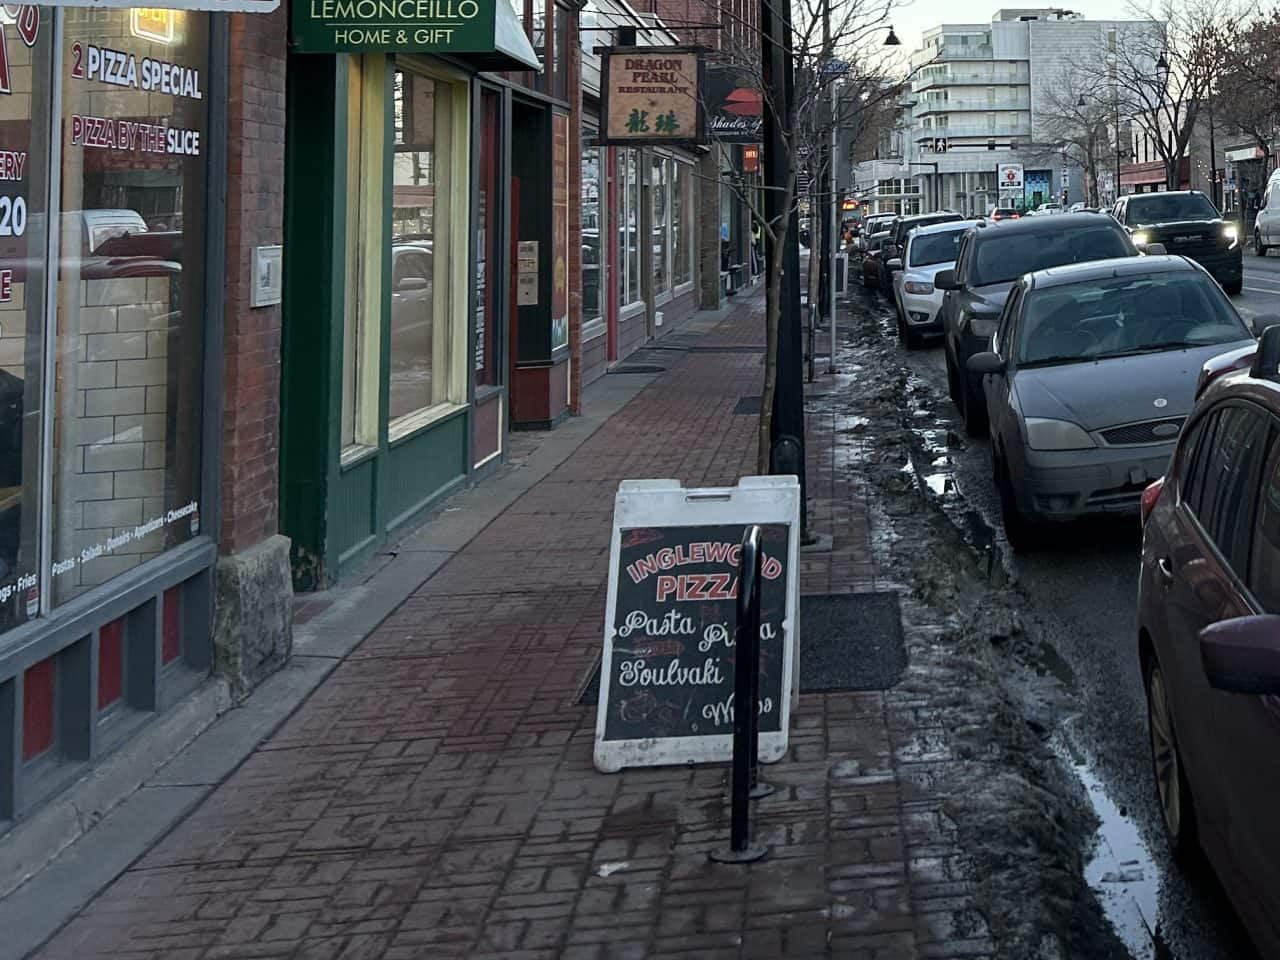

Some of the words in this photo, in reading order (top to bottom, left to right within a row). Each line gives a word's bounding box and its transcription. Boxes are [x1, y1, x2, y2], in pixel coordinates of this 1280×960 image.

[310, 0, 479, 19] LEMONCEILLO
[335, 29, 391, 45] HOME
[395, 29, 408, 45] &
[414, 29, 455, 45] GIFT
[72, 41, 84, 79] 2
[87, 45, 138, 88] PIZZA
[141, 57, 202, 99] SPECIAL
[624, 58, 683, 71] DRAGON
[632, 71, 678, 84] PEARL
[618, 86, 689, 95] RESTAURANT
[72, 114, 117, 149] PIZZA
[117, 121, 139, 151] BY
[139, 124, 166, 154] THE
[167, 128, 200, 156] SLICE
[0, 196, 27, 237] 20
[626, 542, 782, 584] INGLEWOD
[18, 573, 37, 592] Fries
[618, 608, 697, 637] Pasta
[698, 622, 777, 652] Pia
